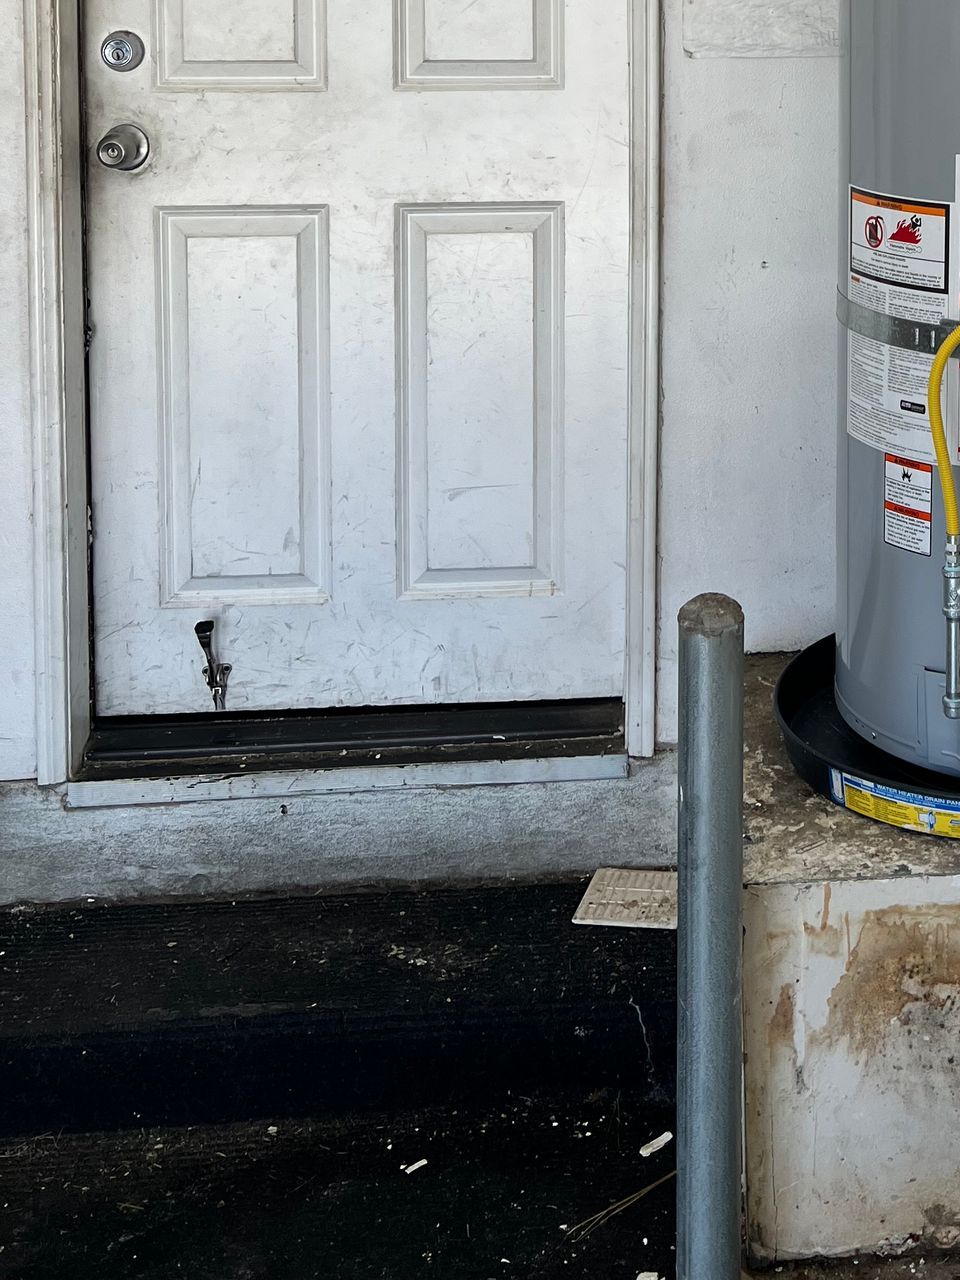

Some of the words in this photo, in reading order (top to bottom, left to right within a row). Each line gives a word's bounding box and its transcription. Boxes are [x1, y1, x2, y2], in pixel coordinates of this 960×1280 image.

[876, 783, 897, 794] WATER
[898, 790, 923, 800] HEATER
[924, 795, 946, 804] DRAIN
